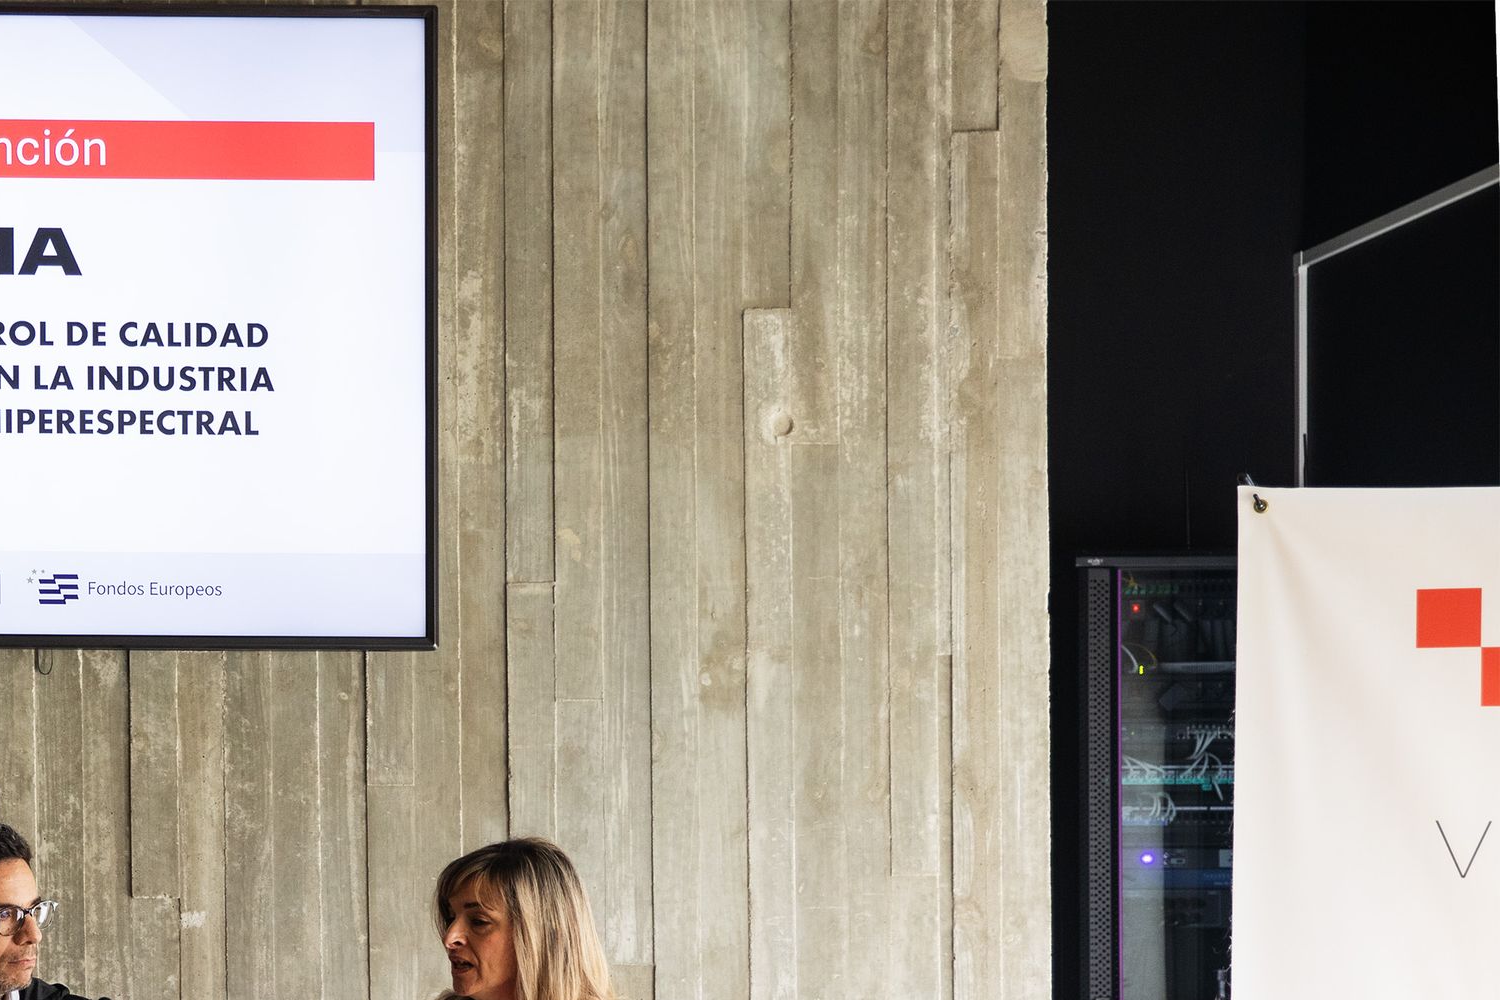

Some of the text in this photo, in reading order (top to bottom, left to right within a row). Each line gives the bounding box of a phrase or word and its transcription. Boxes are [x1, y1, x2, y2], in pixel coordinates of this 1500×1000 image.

[67, 322, 106, 346] DE
[119, 322, 268, 347] CALIDAD
[34, 365, 74, 390] LA
[88, 366, 274, 391] INDUSTRIA
[89, 581, 222, 599] Fondos Europeos
